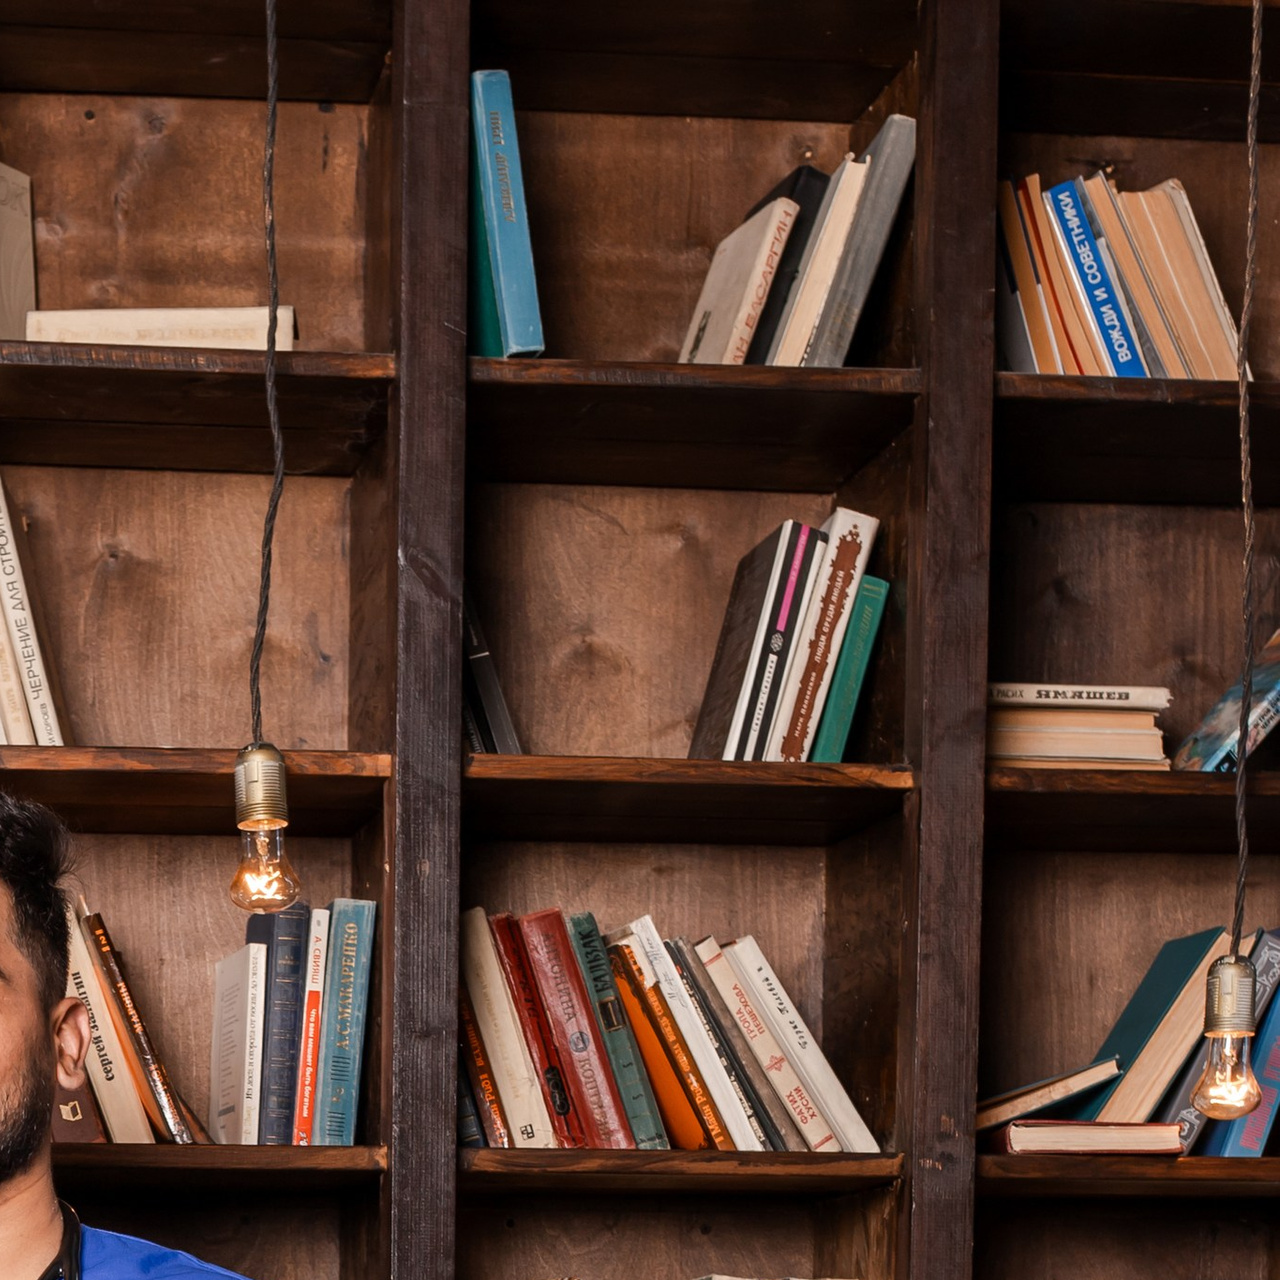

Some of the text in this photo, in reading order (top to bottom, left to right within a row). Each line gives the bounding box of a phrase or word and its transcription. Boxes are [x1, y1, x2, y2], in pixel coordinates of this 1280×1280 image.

[488, 109, 517, 223] АЛЕКСАНДР ГРИН
[741, 208, 795, 330] БАСАРГИН
[1053, 189, 1134, 364] ВОЖДИ И СОВЕТНИКИ
[4, 577, 25, 613] ДЛЯ
[813, 568, 846, 663] ЛЮДИ СРЕДИ ЛЮДЕЙ
[13, 614, 45, 699] ЧЕРЧЕНИЕ
[1035, 688, 1130, 701] ЯМАШЕВ
[309, 947, 321, 984] СВИЯШ
[334, 921, 358, 1050] А.С.МАКАРЕНКО
[575, 927, 614, 995] БАЛЬЗАК
[729, 981, 766, 1036] ПЕШЕХОДА
[760, 974, 789, 1016] Полевой
[733, 1006, 758, 1040] ТРОПА
[300, 1007, 317, 1118] Что вам мешает быть богатым
[698, 1102, 722, 1135] Майн
[782, 1089, 810, 1126] ФАТИХ
[791, 1084, 819, 1121] ХУСНИ
